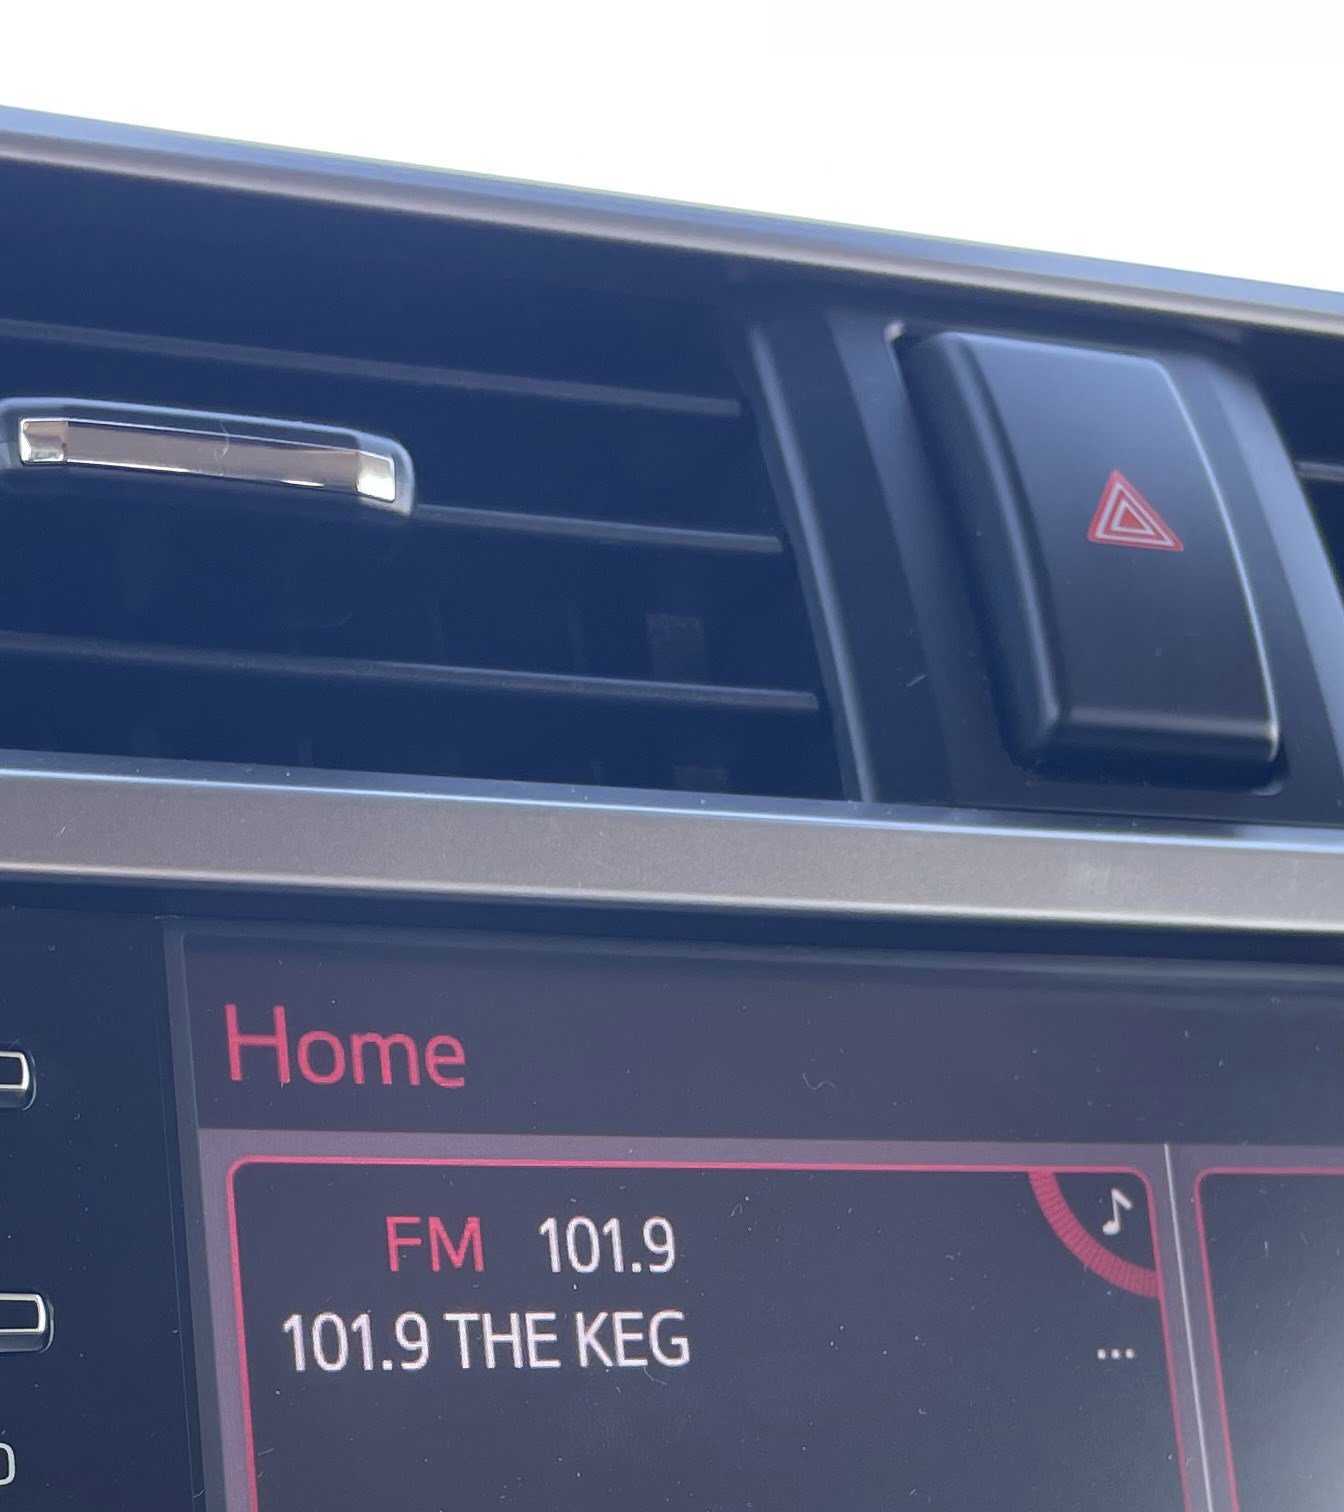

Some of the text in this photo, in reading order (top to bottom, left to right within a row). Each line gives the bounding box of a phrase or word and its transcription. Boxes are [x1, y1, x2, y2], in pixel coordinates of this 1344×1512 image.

[225, 1003, 467, 1089] Home
[385, 1215, 677, 1274] FM 101.9
[282, 1310, 692, 1373] 101.9 THE KEG
